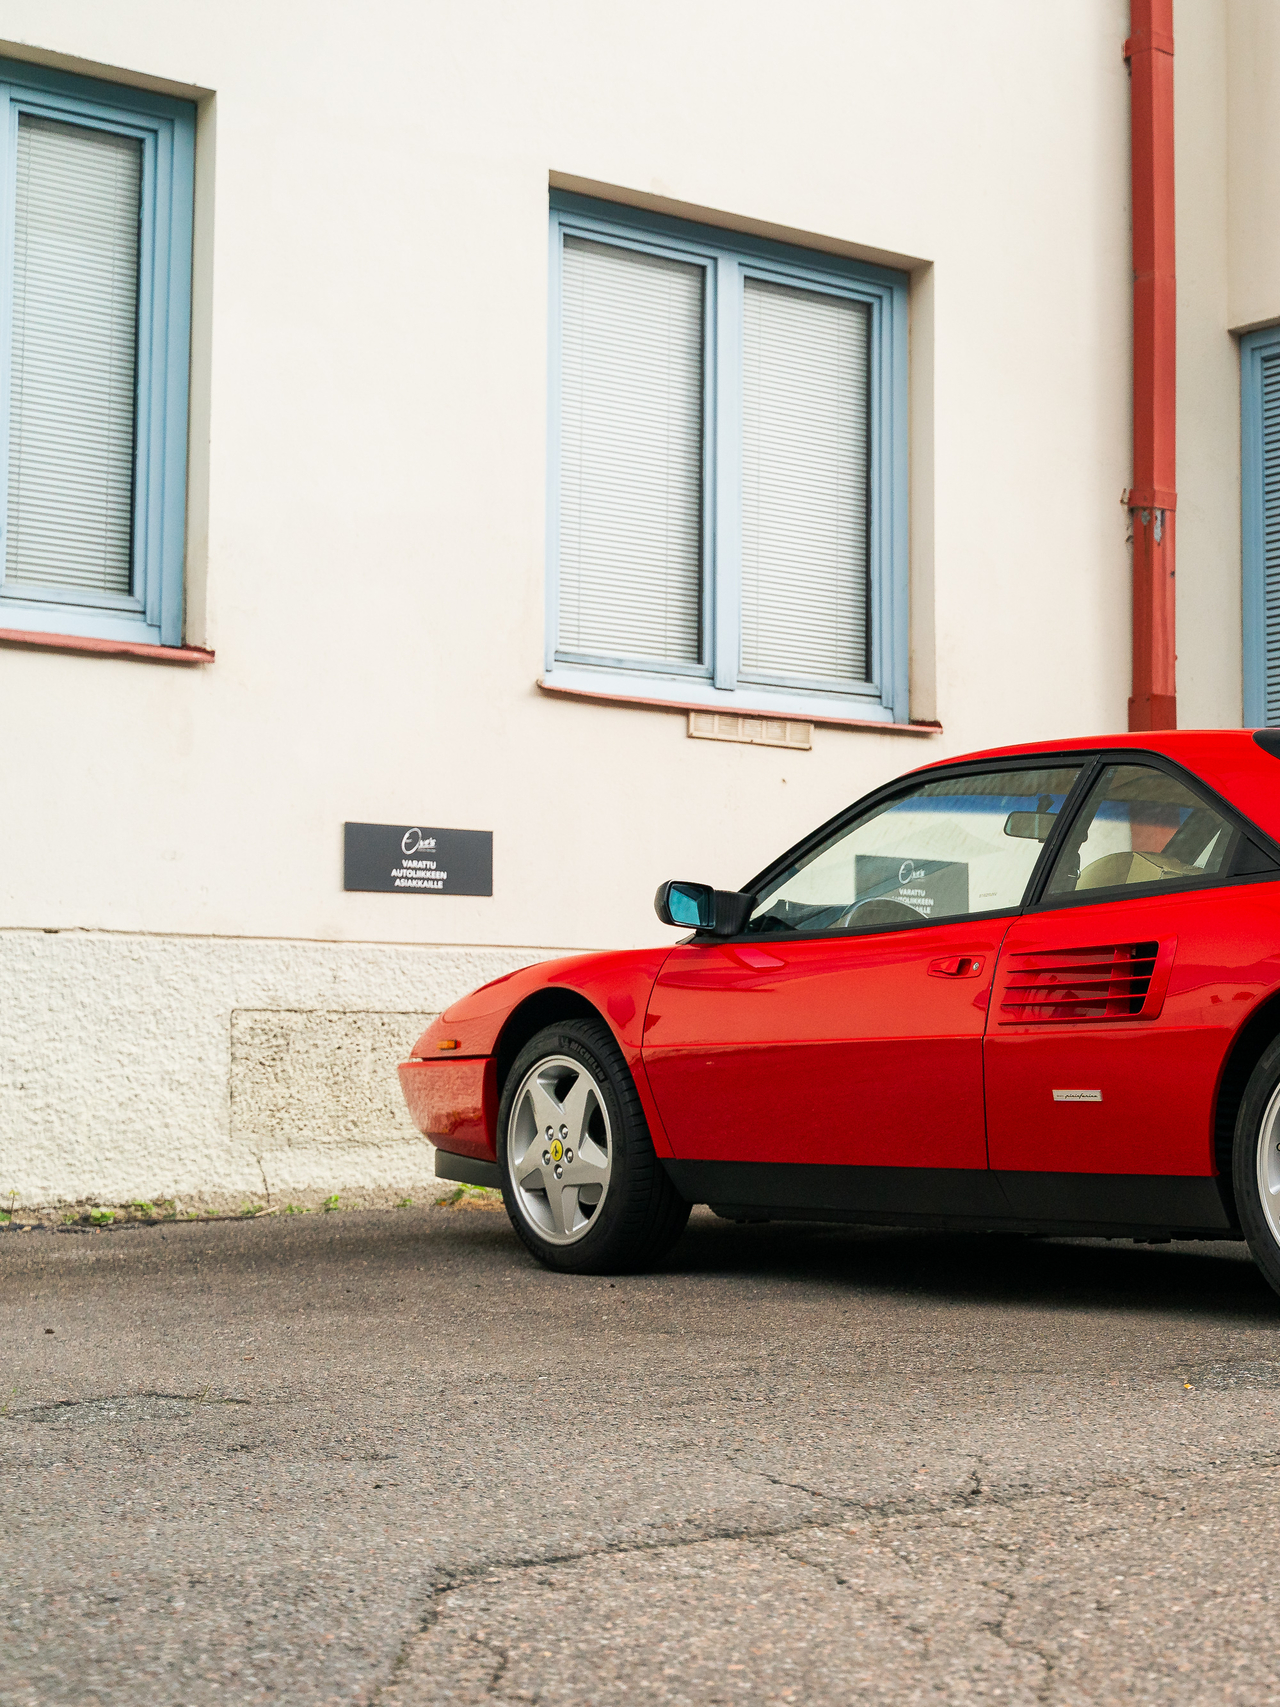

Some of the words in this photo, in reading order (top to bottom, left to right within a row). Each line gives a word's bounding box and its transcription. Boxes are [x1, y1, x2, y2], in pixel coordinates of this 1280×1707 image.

[401, 860, 437, 869] VARATTU
[391, 869, 448, 880] AUTOLIIKKEEN
[394, 879, 444, 889] ASIAKKAILLE
[898, 888, 927, 897] VARATTU
[569, 1040, 606, 1082] MICHELIN
